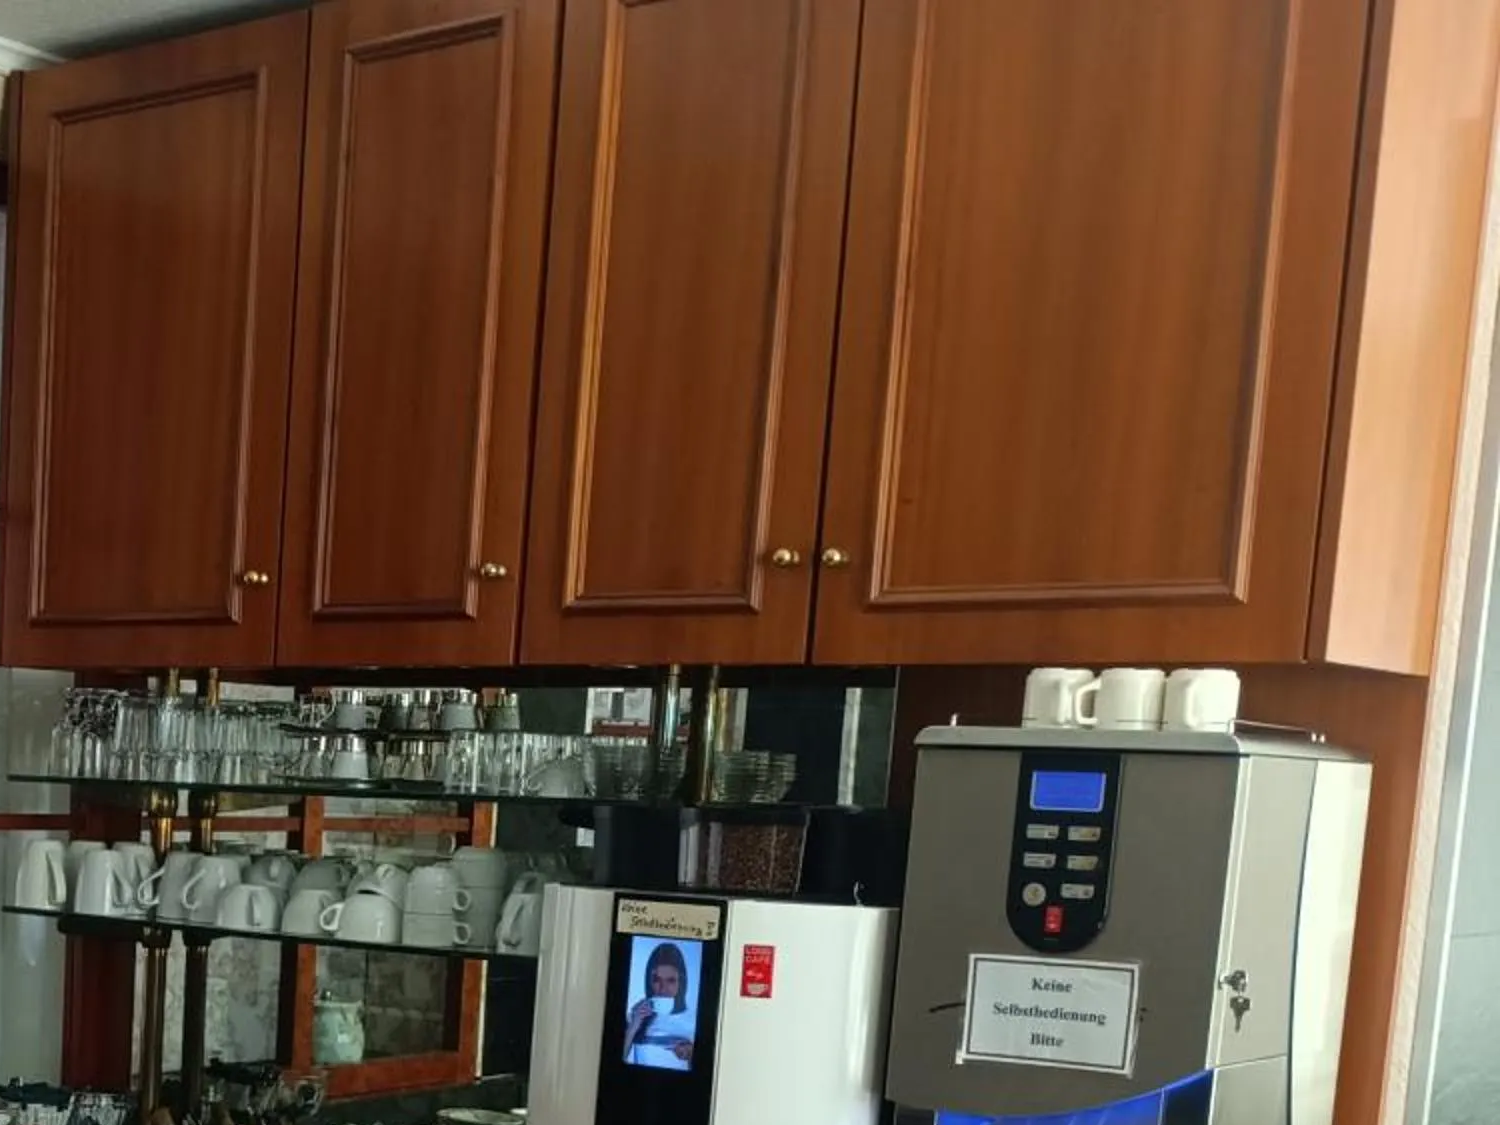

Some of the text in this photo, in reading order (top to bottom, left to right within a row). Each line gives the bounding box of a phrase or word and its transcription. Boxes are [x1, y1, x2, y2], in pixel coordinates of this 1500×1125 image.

[1031, 977, 1073, 993] Keine
[993, 1002, 1106, 1026] Selbstbedienung
[1030, 1032, 1064, 1047] Bitte
